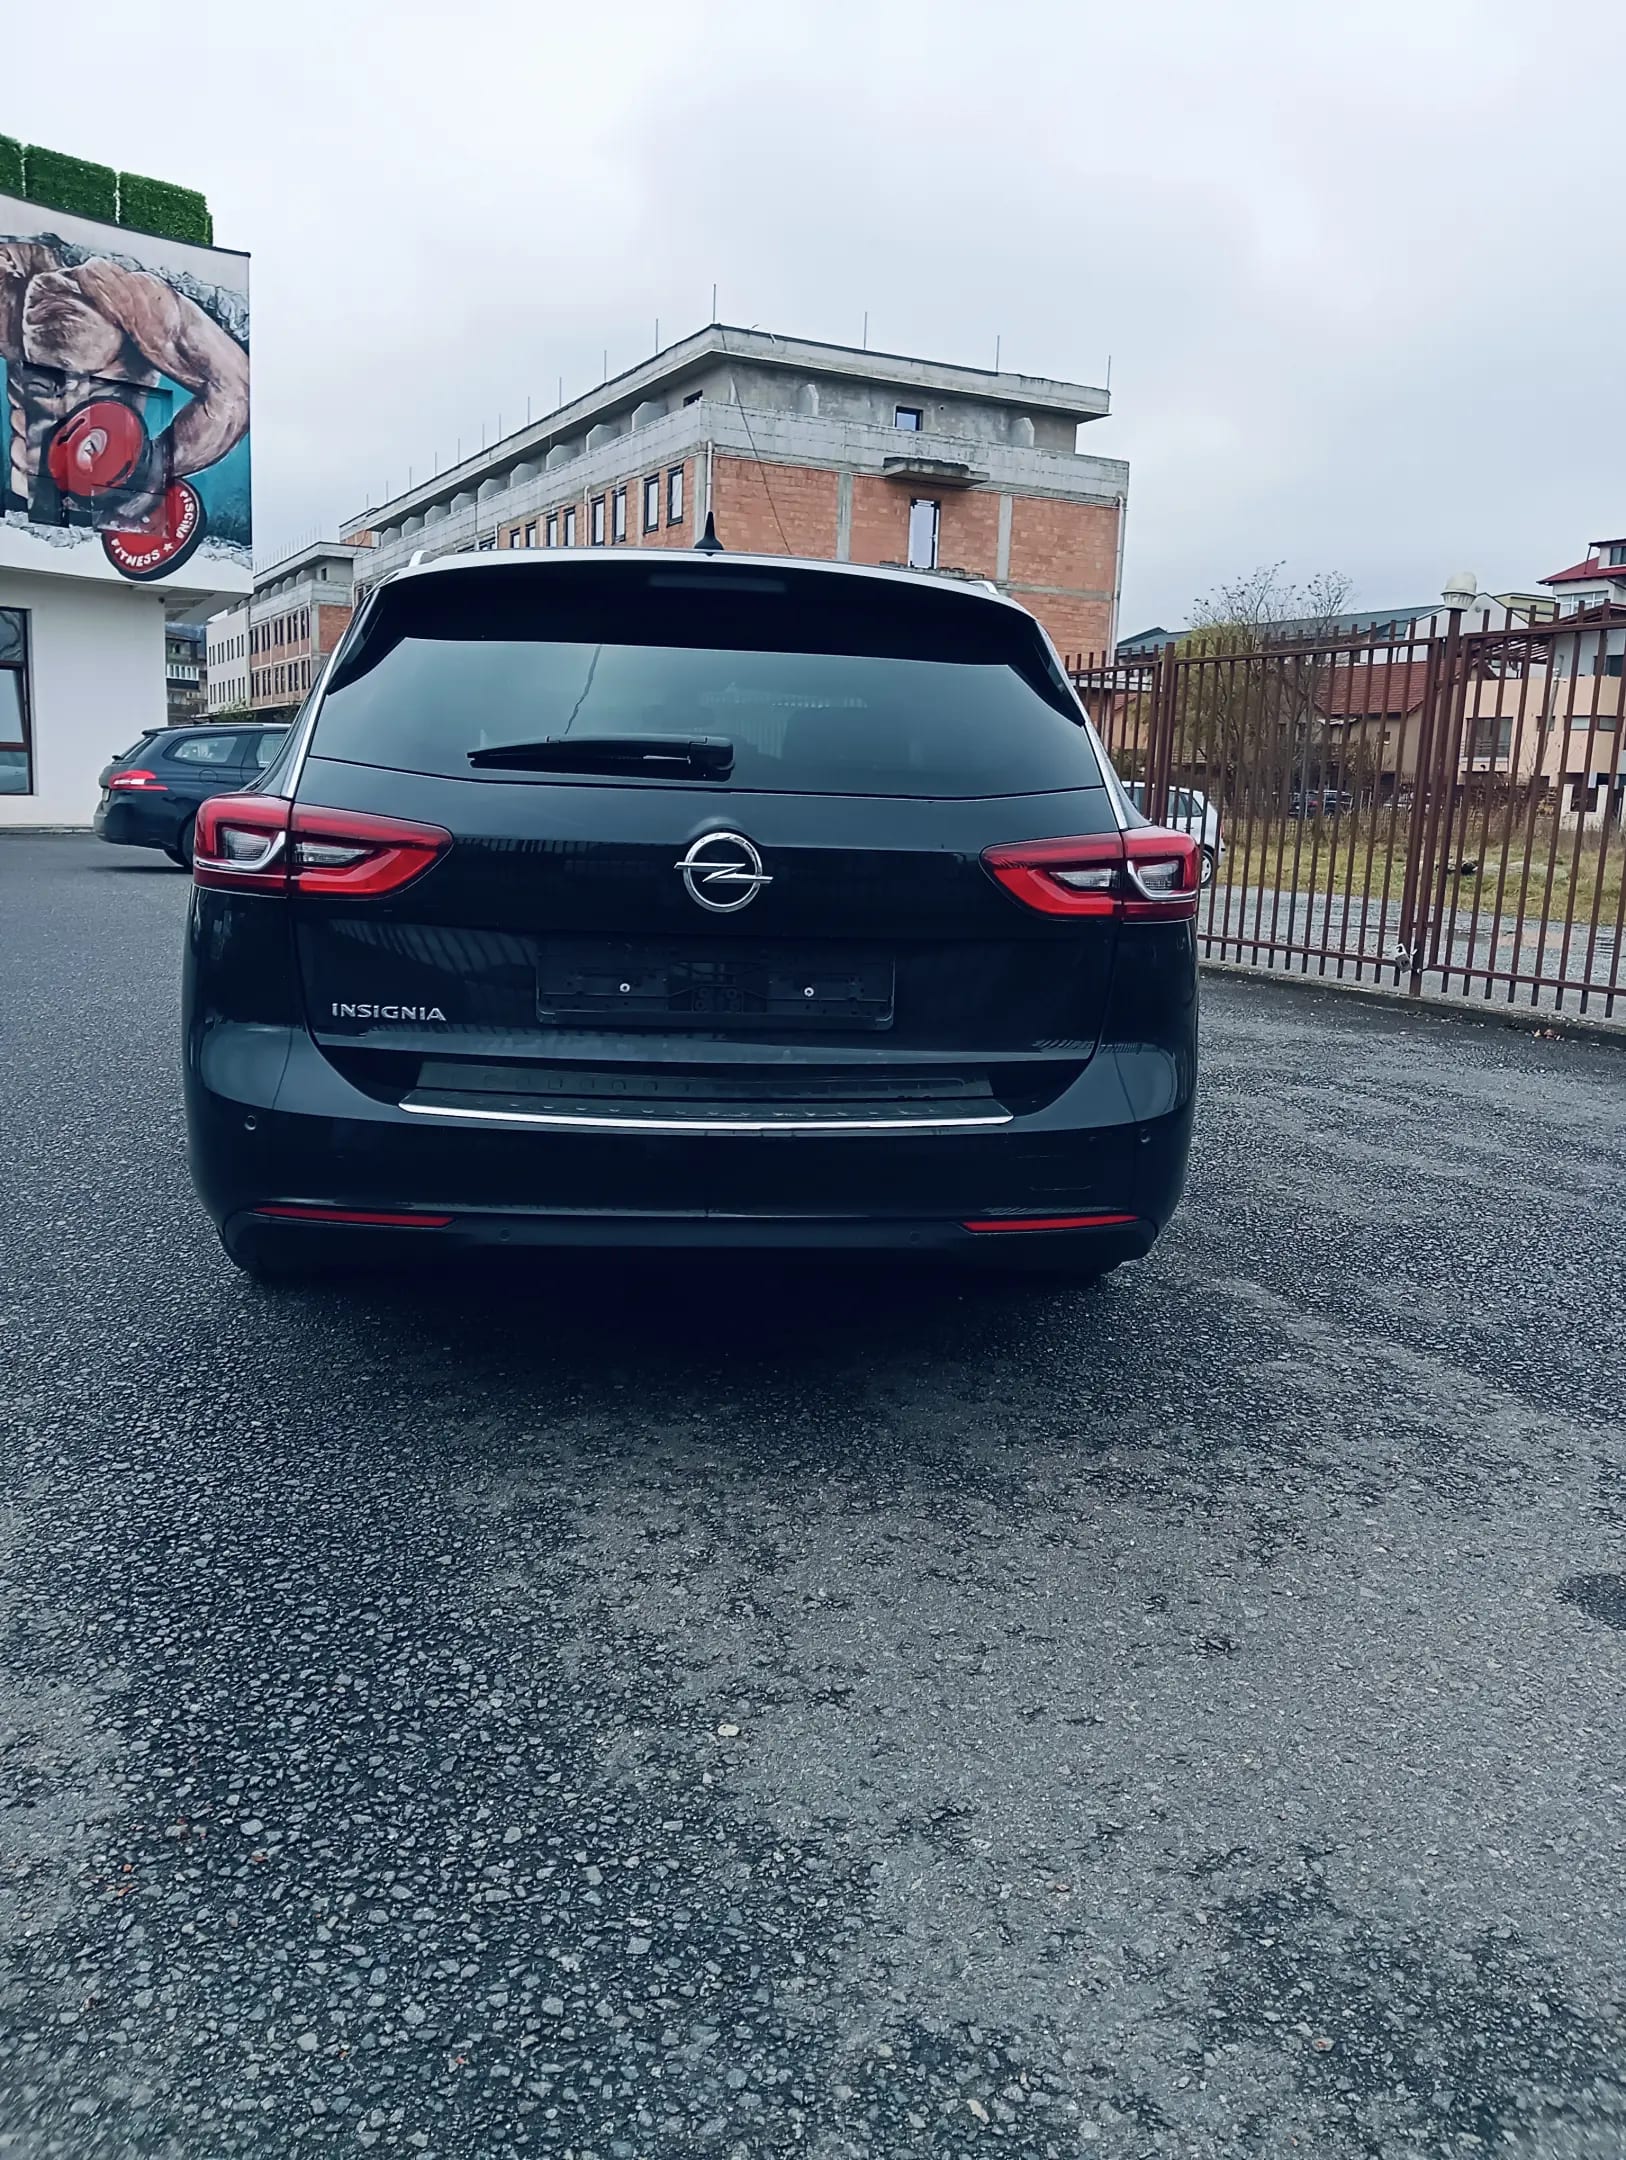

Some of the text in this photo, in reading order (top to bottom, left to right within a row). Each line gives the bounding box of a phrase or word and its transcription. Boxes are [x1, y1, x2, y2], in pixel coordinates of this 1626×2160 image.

[177, 490, 194, 538] PISCINA
[111, 538, 160, 566] FITNESS
[332, 1003, 447, 1021] INSIGNIA
